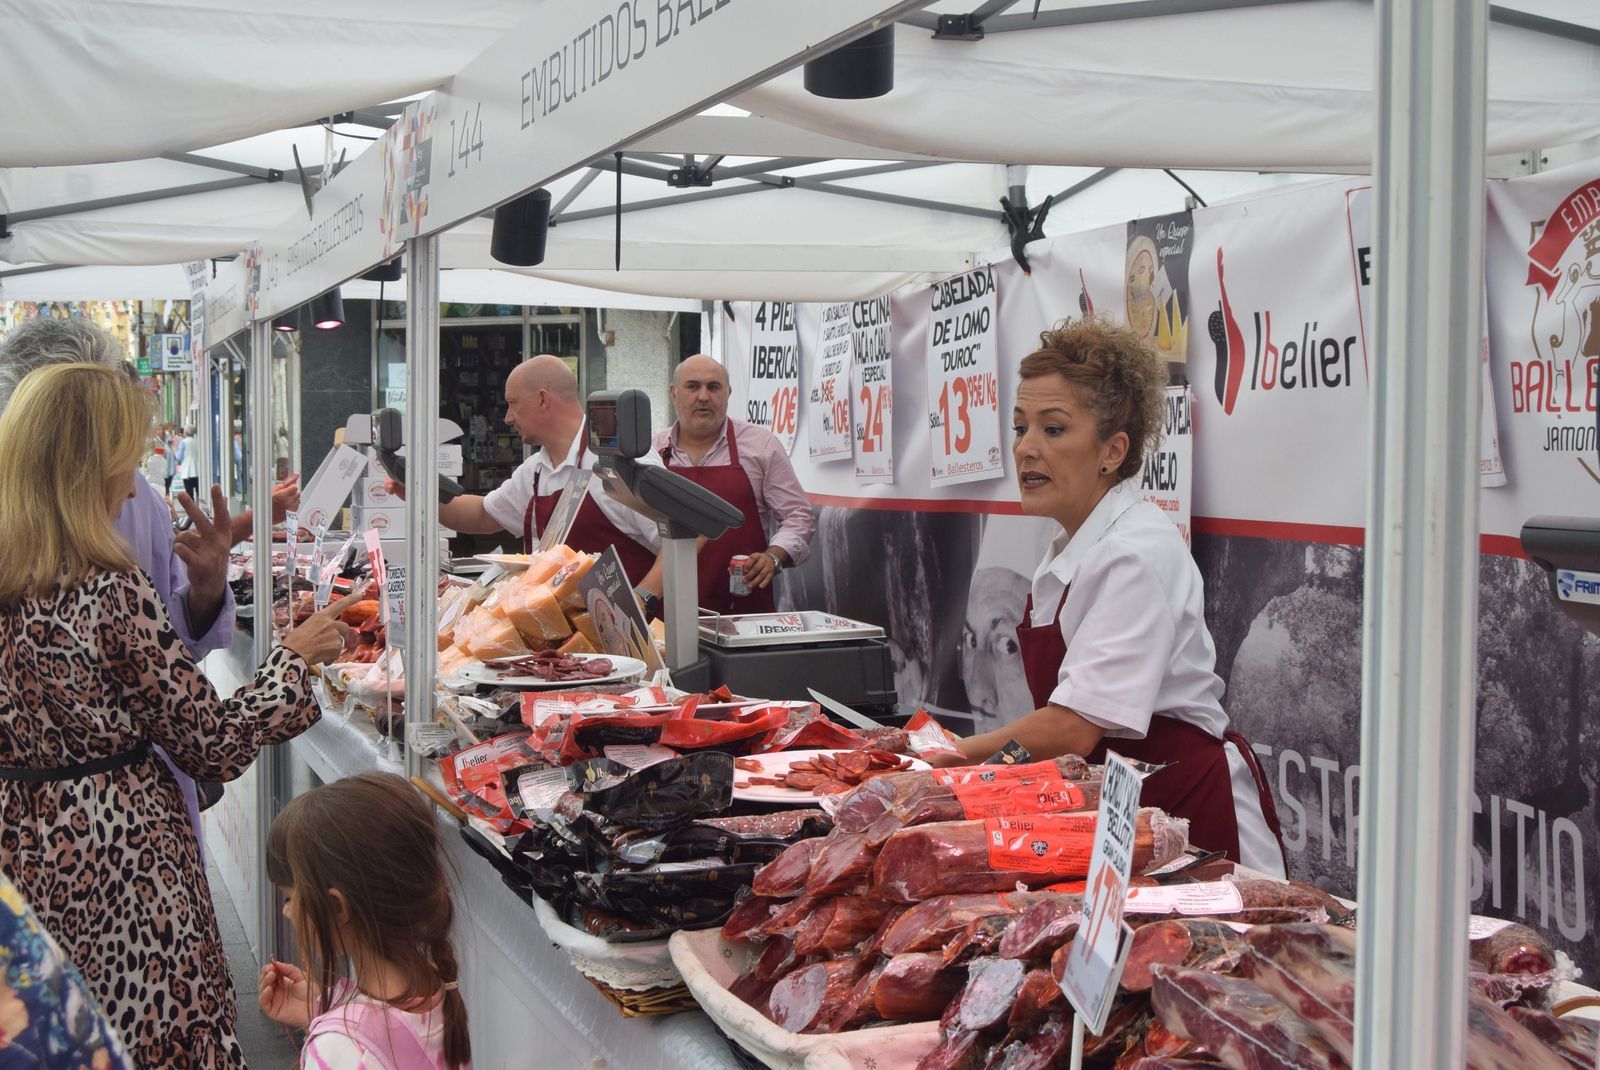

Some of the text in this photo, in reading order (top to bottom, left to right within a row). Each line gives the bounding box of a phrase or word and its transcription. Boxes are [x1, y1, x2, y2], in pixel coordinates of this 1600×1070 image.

[448, 102, 484, 178] 144
[520, 0, 647, 131] EMBUTIDOS
[931, 265, 996, 312] CABELADA
[755, 302, 767, 332] 4
[852, 294, 891, 329] CECINA
[933, 306, 990, 347] DE LOMO
[752, 345, 798, 380] IBERICAS
[941, 342, 982, 373] "DUROC"
[1251, 310, 1356, 391] Ibelier
[771, 386, 798, 434] 10€
[832, 398, 849, 434] 10€
[860, 386, 883, 453] 24
[1250, 742, 1361, 868] STA
